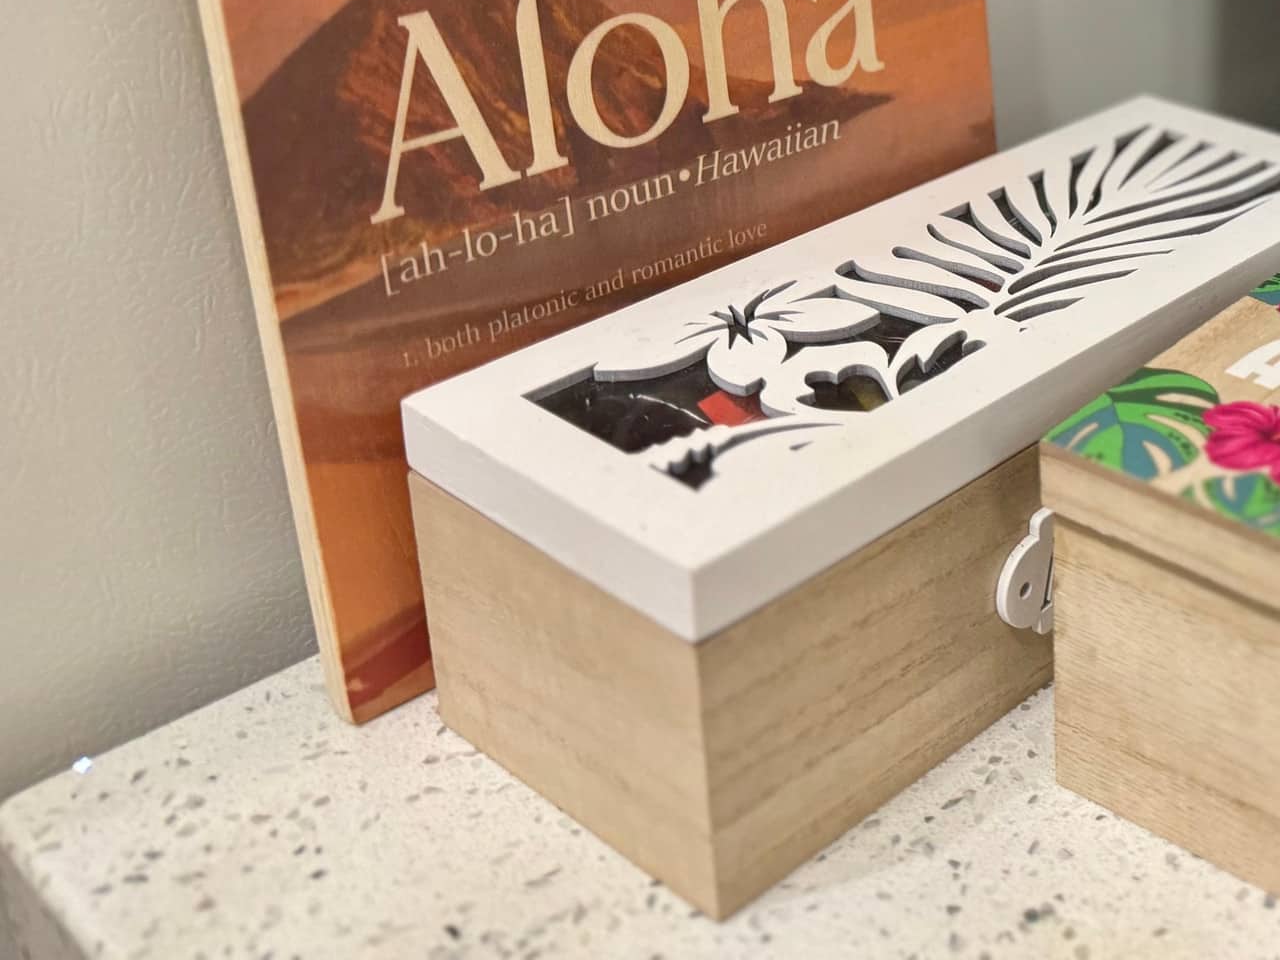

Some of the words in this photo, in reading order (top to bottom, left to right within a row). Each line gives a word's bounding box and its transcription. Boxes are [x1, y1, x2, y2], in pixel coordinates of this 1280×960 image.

[380, 196, 576, 297] [ah-lo-ha]
[425, 322, 480, 360] both
[487, 286, 581, 344] platonic
[584, 268, 626, 302] and
[630, 236, 724, 284] romantic
[727, 220, 769, 248] love
